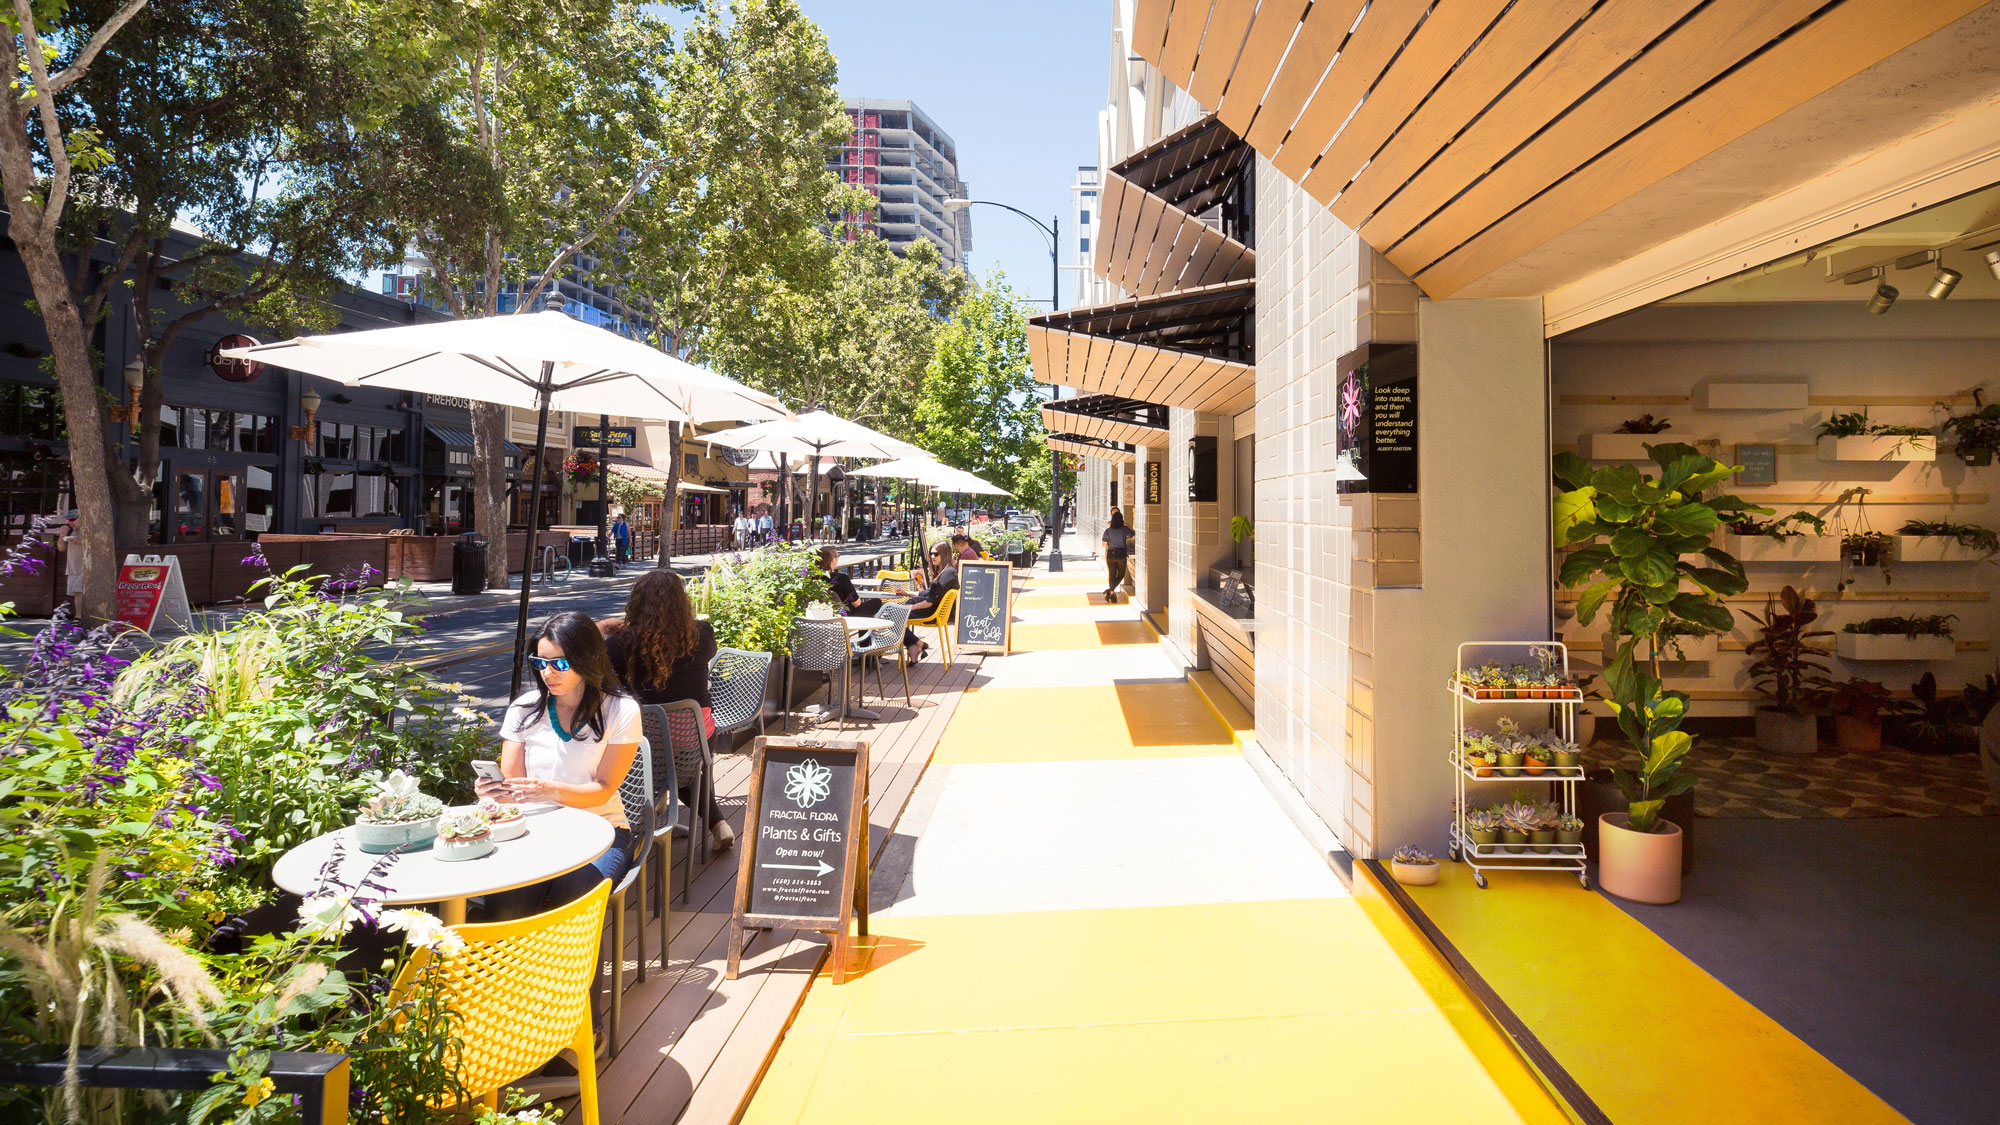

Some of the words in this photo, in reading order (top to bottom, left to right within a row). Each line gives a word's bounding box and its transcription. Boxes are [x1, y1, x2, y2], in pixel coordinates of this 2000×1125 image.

[1392, 387, 1410, 396] deep
[426, 393, 470, 409] FIREHOUS
[1375, 412, 1388, 420] you
[1375, 428, 1411, 437] everything
[1150, 464, 1158, 501] MOMENT
[769, 810, 807, 820] FRACTAL
[809, 812, 838, 821] FLORA
[762, 826, 798, 840] Plants
[800, 828, 810, 841] &
[813, 828, 841, 842] Gifts
[776, 847, 798, 858] Open
[801, 849, 825, 858] now!
[772, 878, 790, 886] (650)
[762, 887, 830, 895] www.fractalflora.com
